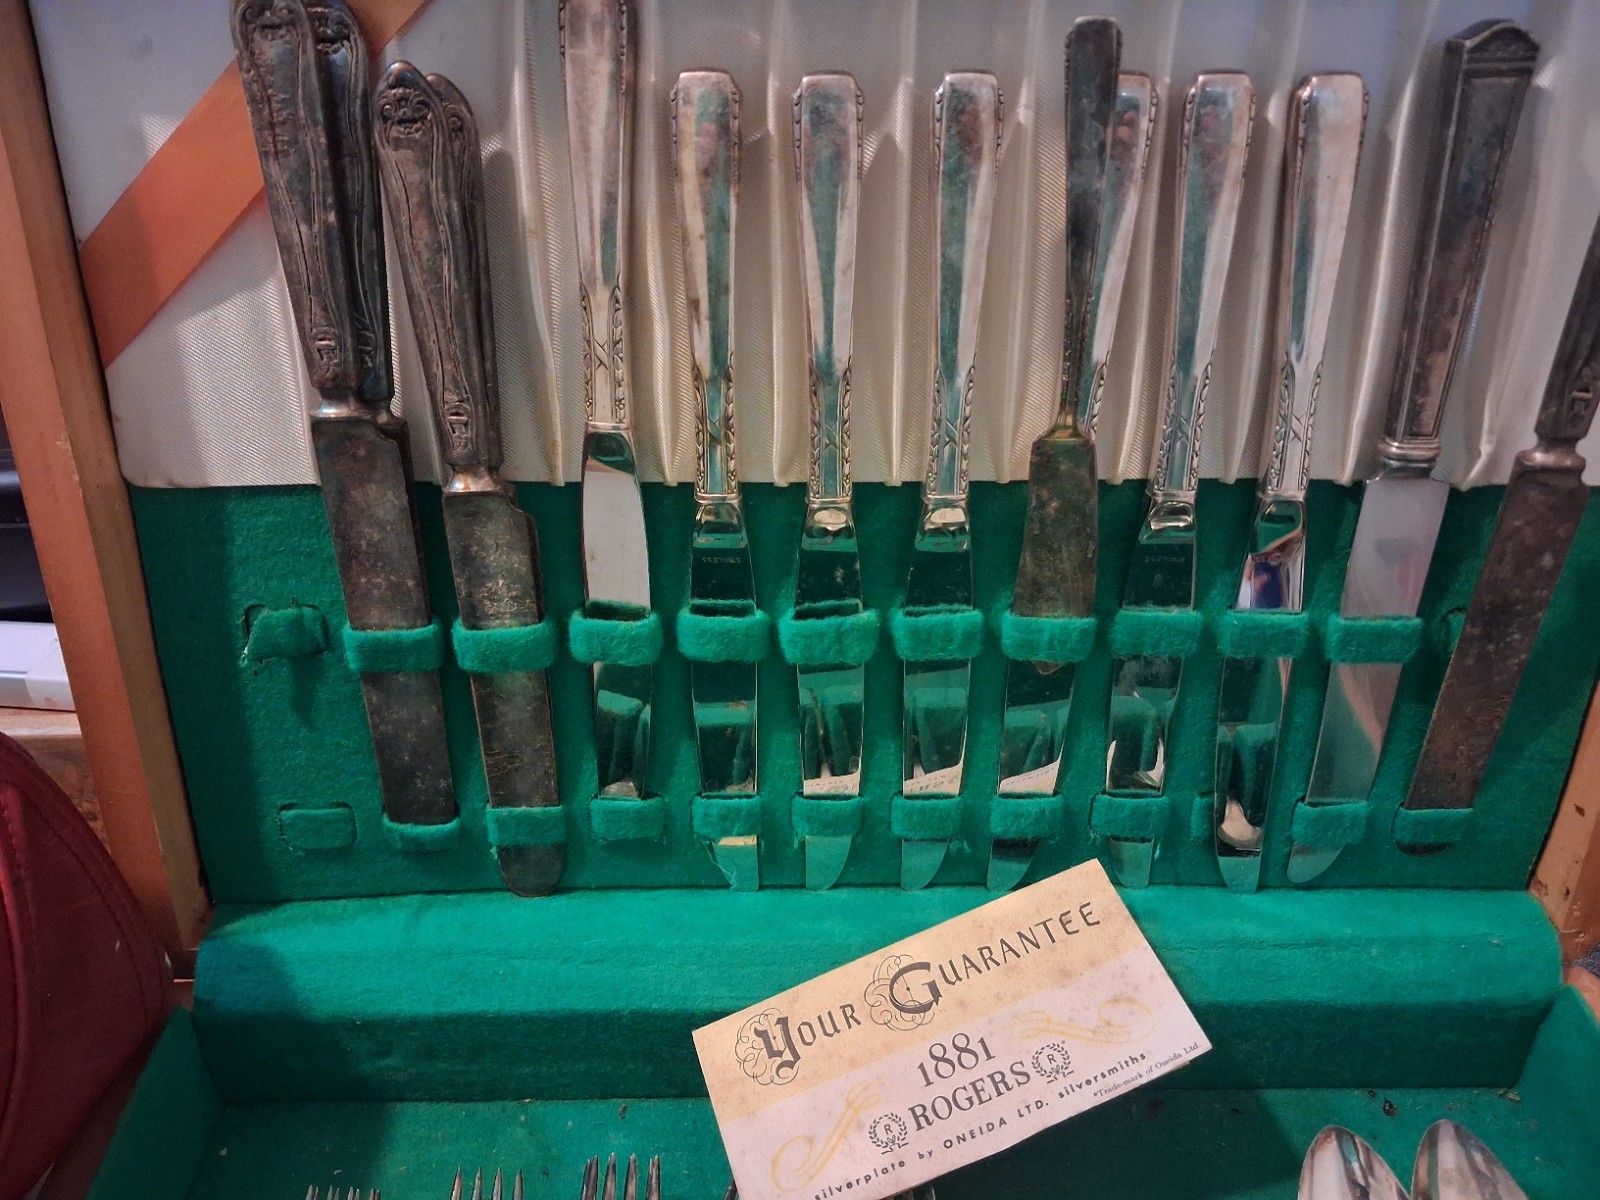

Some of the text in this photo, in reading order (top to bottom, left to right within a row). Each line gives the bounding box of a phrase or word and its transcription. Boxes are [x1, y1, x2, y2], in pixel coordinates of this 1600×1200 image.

[888, 901, 1101, 1014] GUARANTEE
[883, 1053, 1056, 1135] R ROGERS R
[917, 1033, 996, 1087] 1881
[1145, 1065, 1155, 1076] of
[1154, 1052, 1183, 1070] Oneida
[1183, 1041, 1202, 1055] Ltd.
[814, 1052, 1147, 1200] silverplate by ONEIDA LTD. silversmiths
